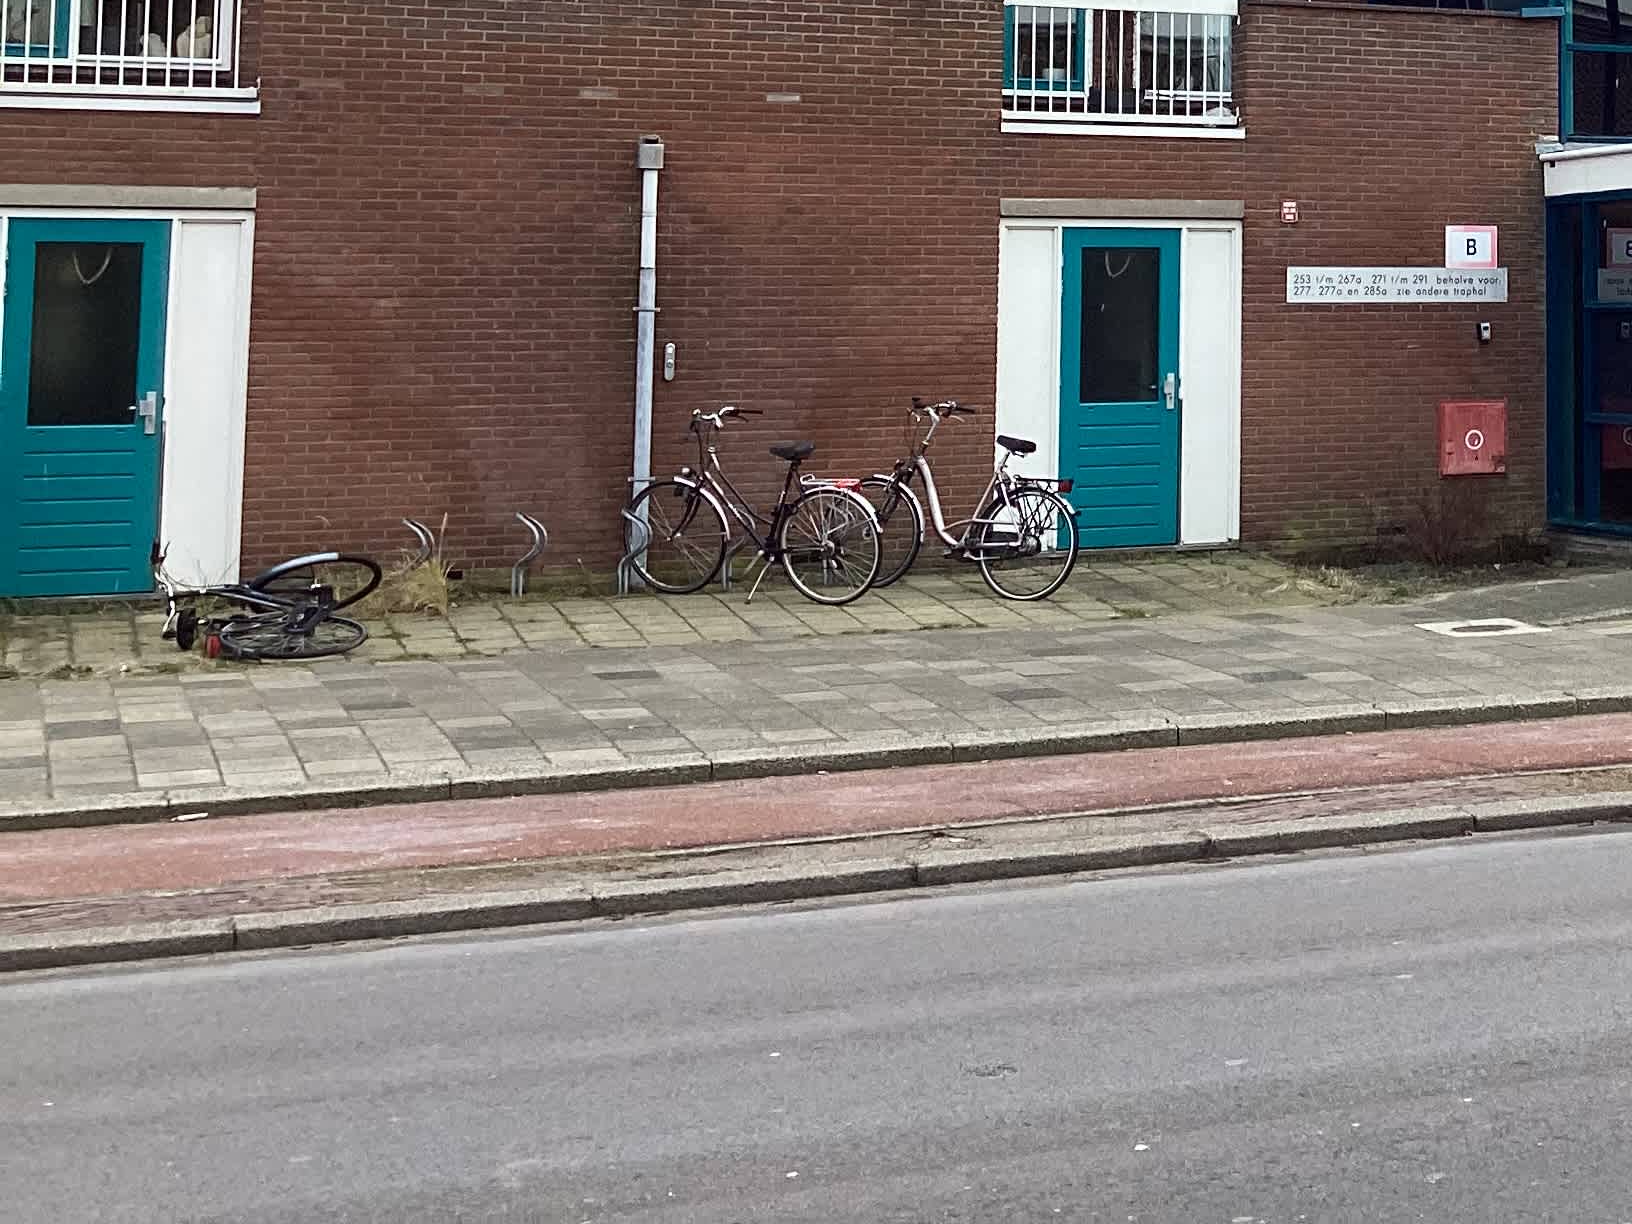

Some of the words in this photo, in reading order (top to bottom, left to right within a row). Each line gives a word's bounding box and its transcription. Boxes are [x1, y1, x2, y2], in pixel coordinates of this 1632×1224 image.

[1466, 238, 1477, 256] B
[1294, 274, 1311, 284] 253
[1436, 274, 1474, 285] behalve
[1318, 286, 1342, 296] 277a
[1397, 287, 1410, 296] zie
[1416, 286, 1449, 296] andere
[1453, 286, 1486, 298] traphal
